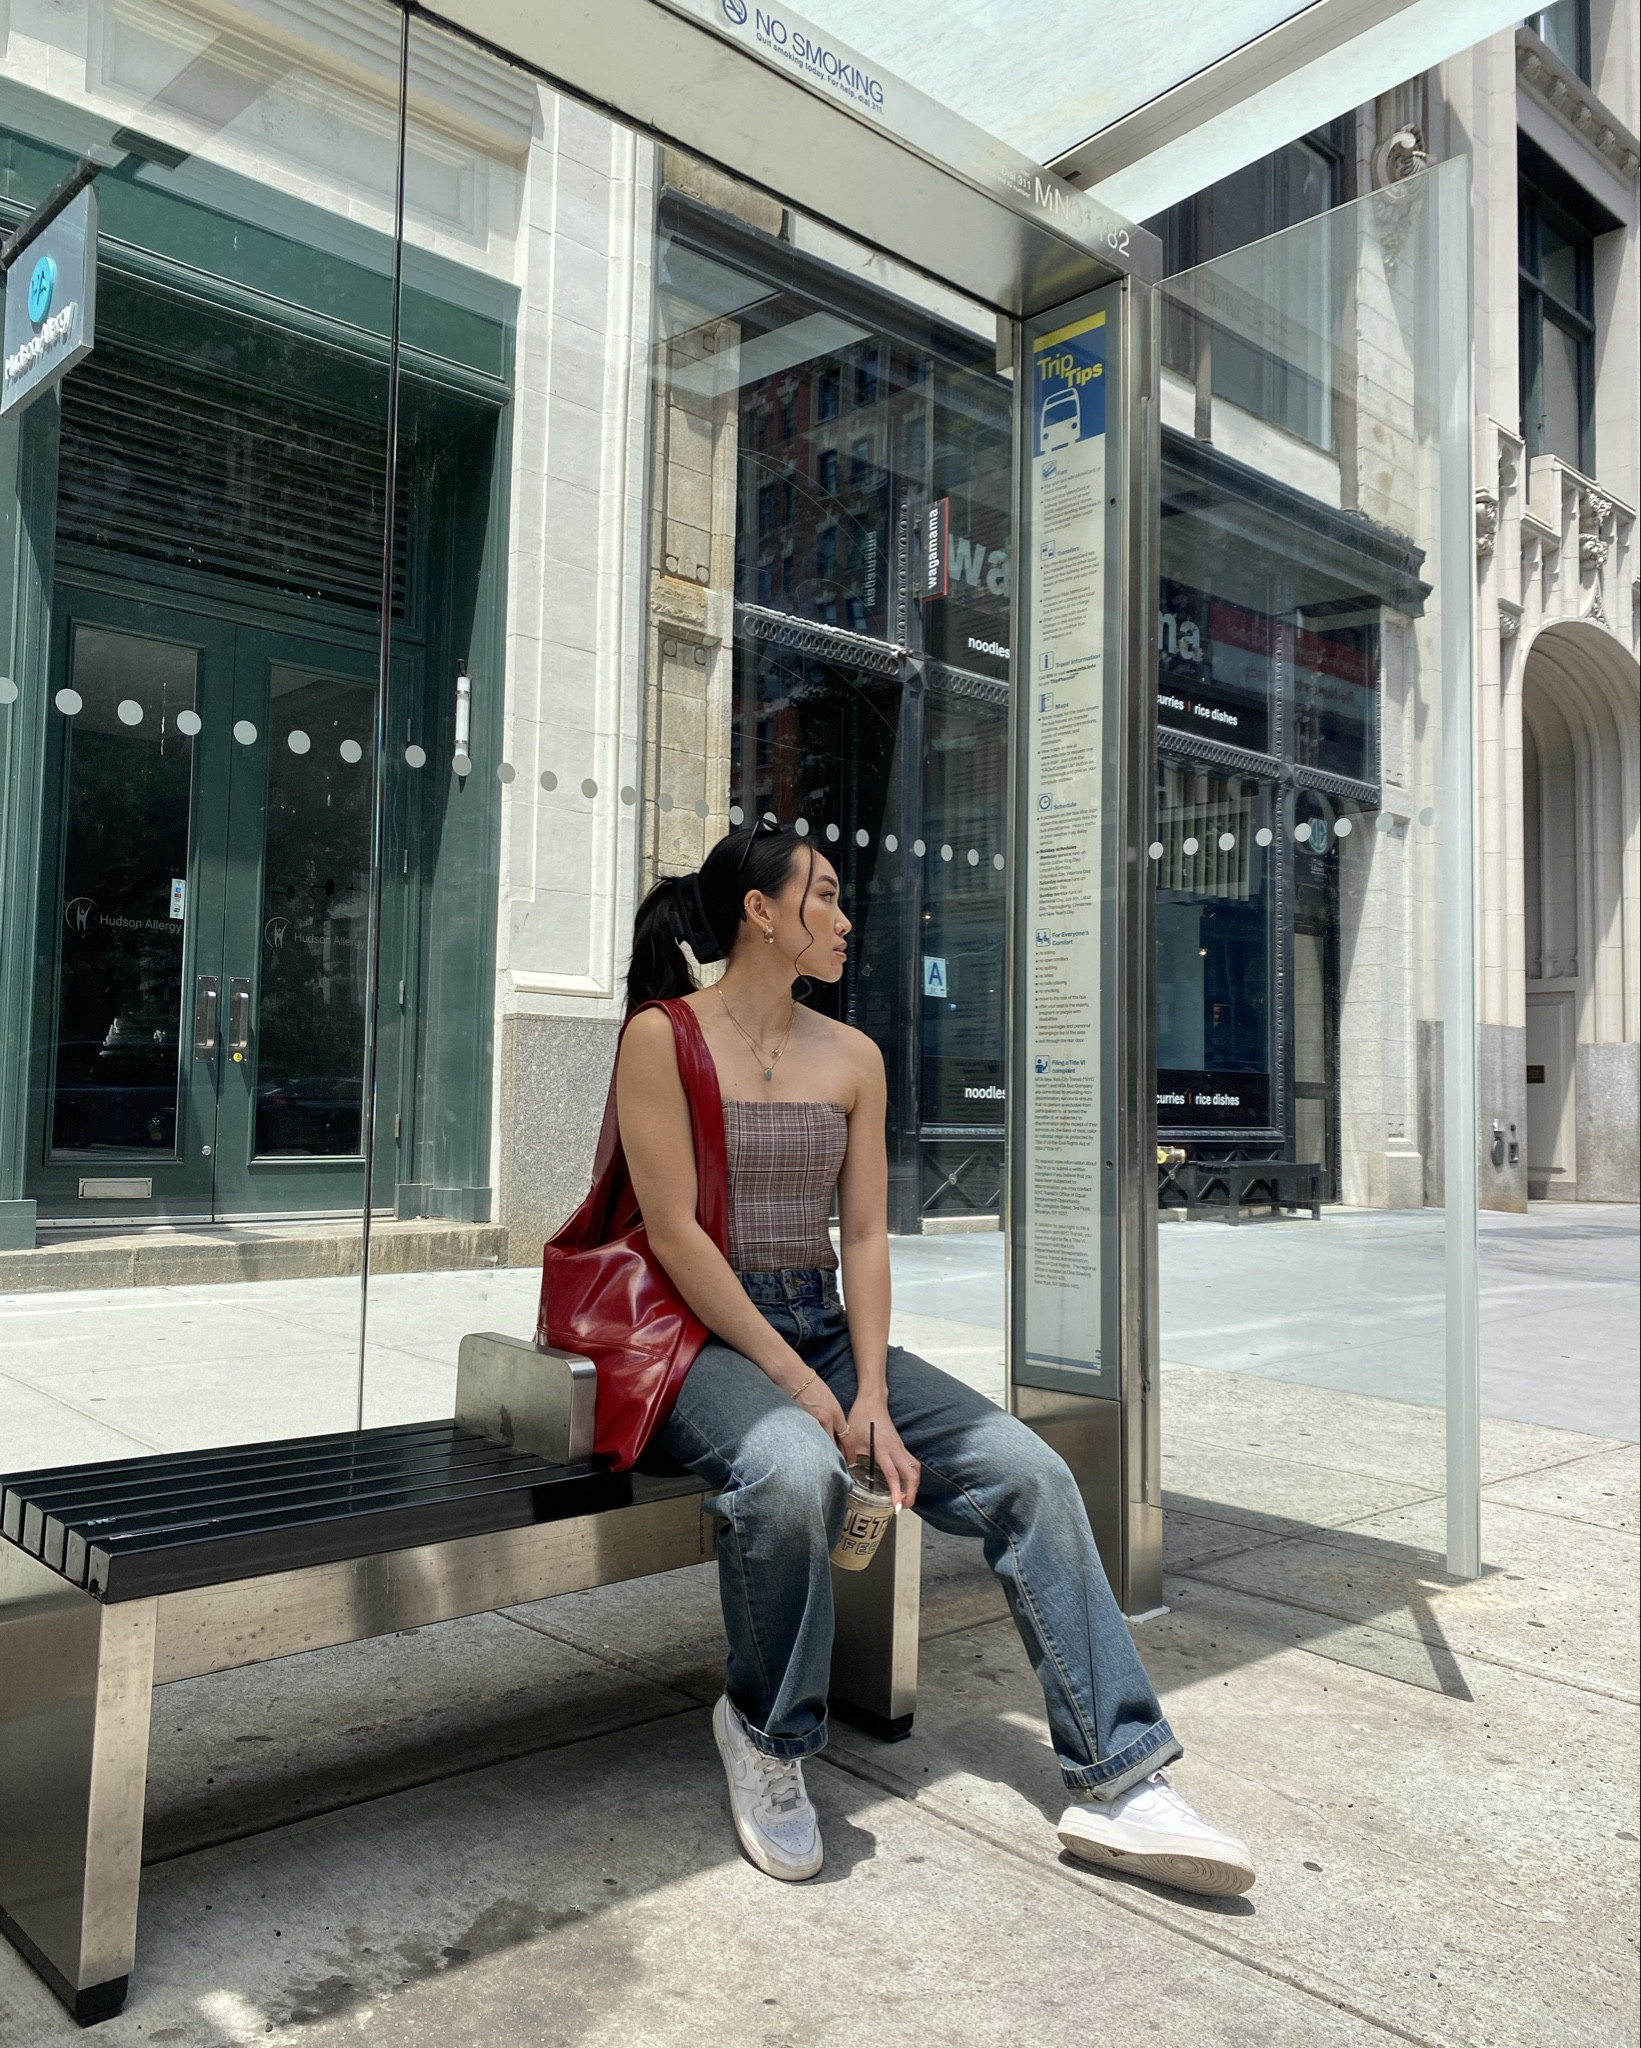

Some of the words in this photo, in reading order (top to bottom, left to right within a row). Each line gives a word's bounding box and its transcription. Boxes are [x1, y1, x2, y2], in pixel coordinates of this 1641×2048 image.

[756, 8, 787, 45] NO
[792, 32, 884, 105] SMOKING
[756, 33, 772, 47] Quit
[773, 44, 804, 69] smoking
[805, 63, 826, 81] today.
[827, 75, 838, 88] For
[840, 83, 857, 100] help,
[858, 94, 870, 107] dial
[1001, 165, 1016, 182] Dial
[1017, 174, 1031, 191] 311
[1037, 353, 1074, 381] Trip
[1066, 362, 1103, 388] Tips
[928, 508, 940, 589] wagamama
[968, 637, 1011, 659] noodles
[1071, 654, 1100, 665] Information
[1194, 703, 1211, 719] rice
[1211, 708, 1238, 727] dishes
[1054, 801, 1077, 810] Schedule
[100, 914, 143, 931] Hudson
[144, 918, 182, 934] Allergy
[1061, 930, 1089, 938] Everyone's
[294, 932, 331, 946] Hudson
[333, 936, 367, 950] Allergy
[928, 961, 944, 987] A
[1195, 1092, 1212, 1106] rice
[1213, 1092, 1240, 1107] dishes
